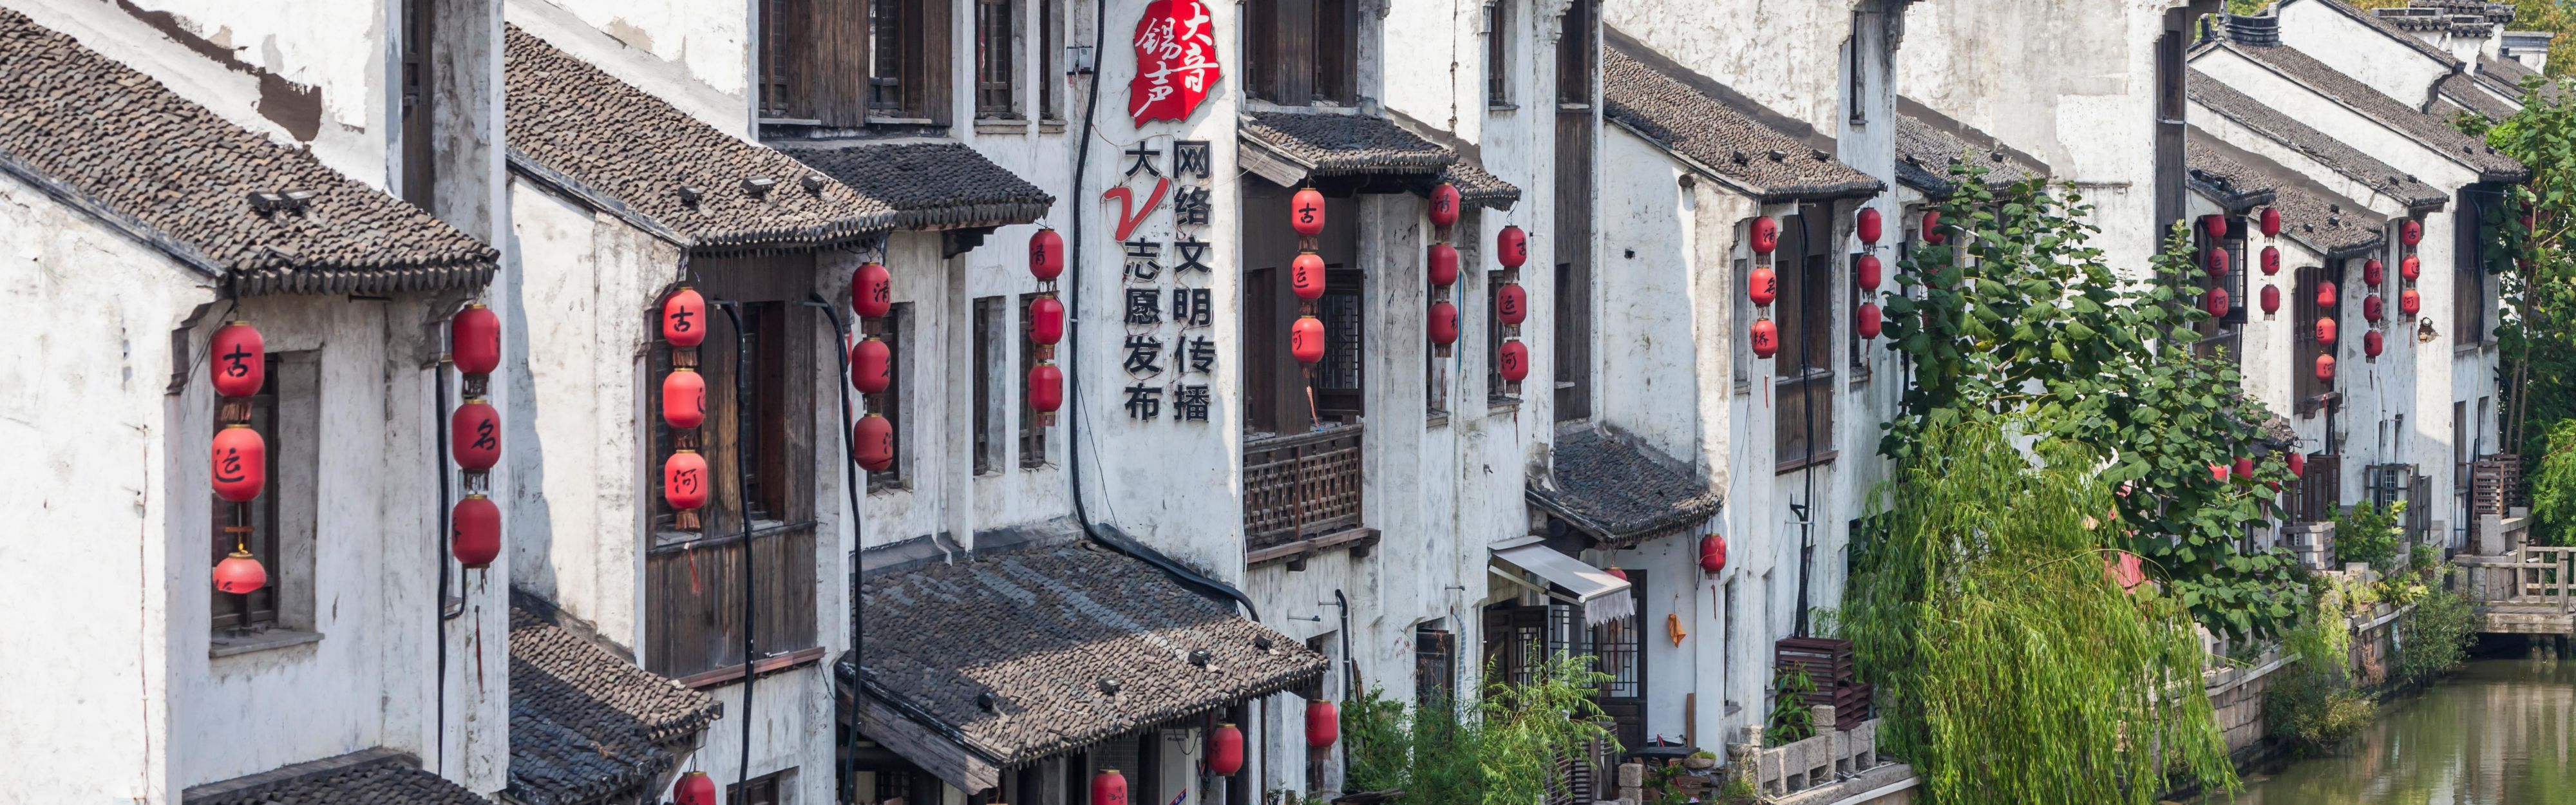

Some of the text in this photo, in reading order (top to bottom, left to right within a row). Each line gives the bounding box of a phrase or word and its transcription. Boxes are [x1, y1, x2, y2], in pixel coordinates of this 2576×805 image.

[1170, 2, 1219, 93] 大音
[1299, 203, 1316, 223] 古
[1763, 228, 1776, 245] 清
[2408, 228, 2418, 240] 古
[1031, 243, 1046, 266] 清
[1173, 140, 1216, 422] 网络文明传播
[1293, 267, 1309, 289] 运
[1500, 295, 1517, 316] 运
[670, 305, 694, 332] 古
[223, 344, 252, 377] 古
[1501, 352, 1517, 371] 河
[471, 419, 496, 451] 名
[214, 448, 245, 483] 运
[674, 468, 697, 495] 河
